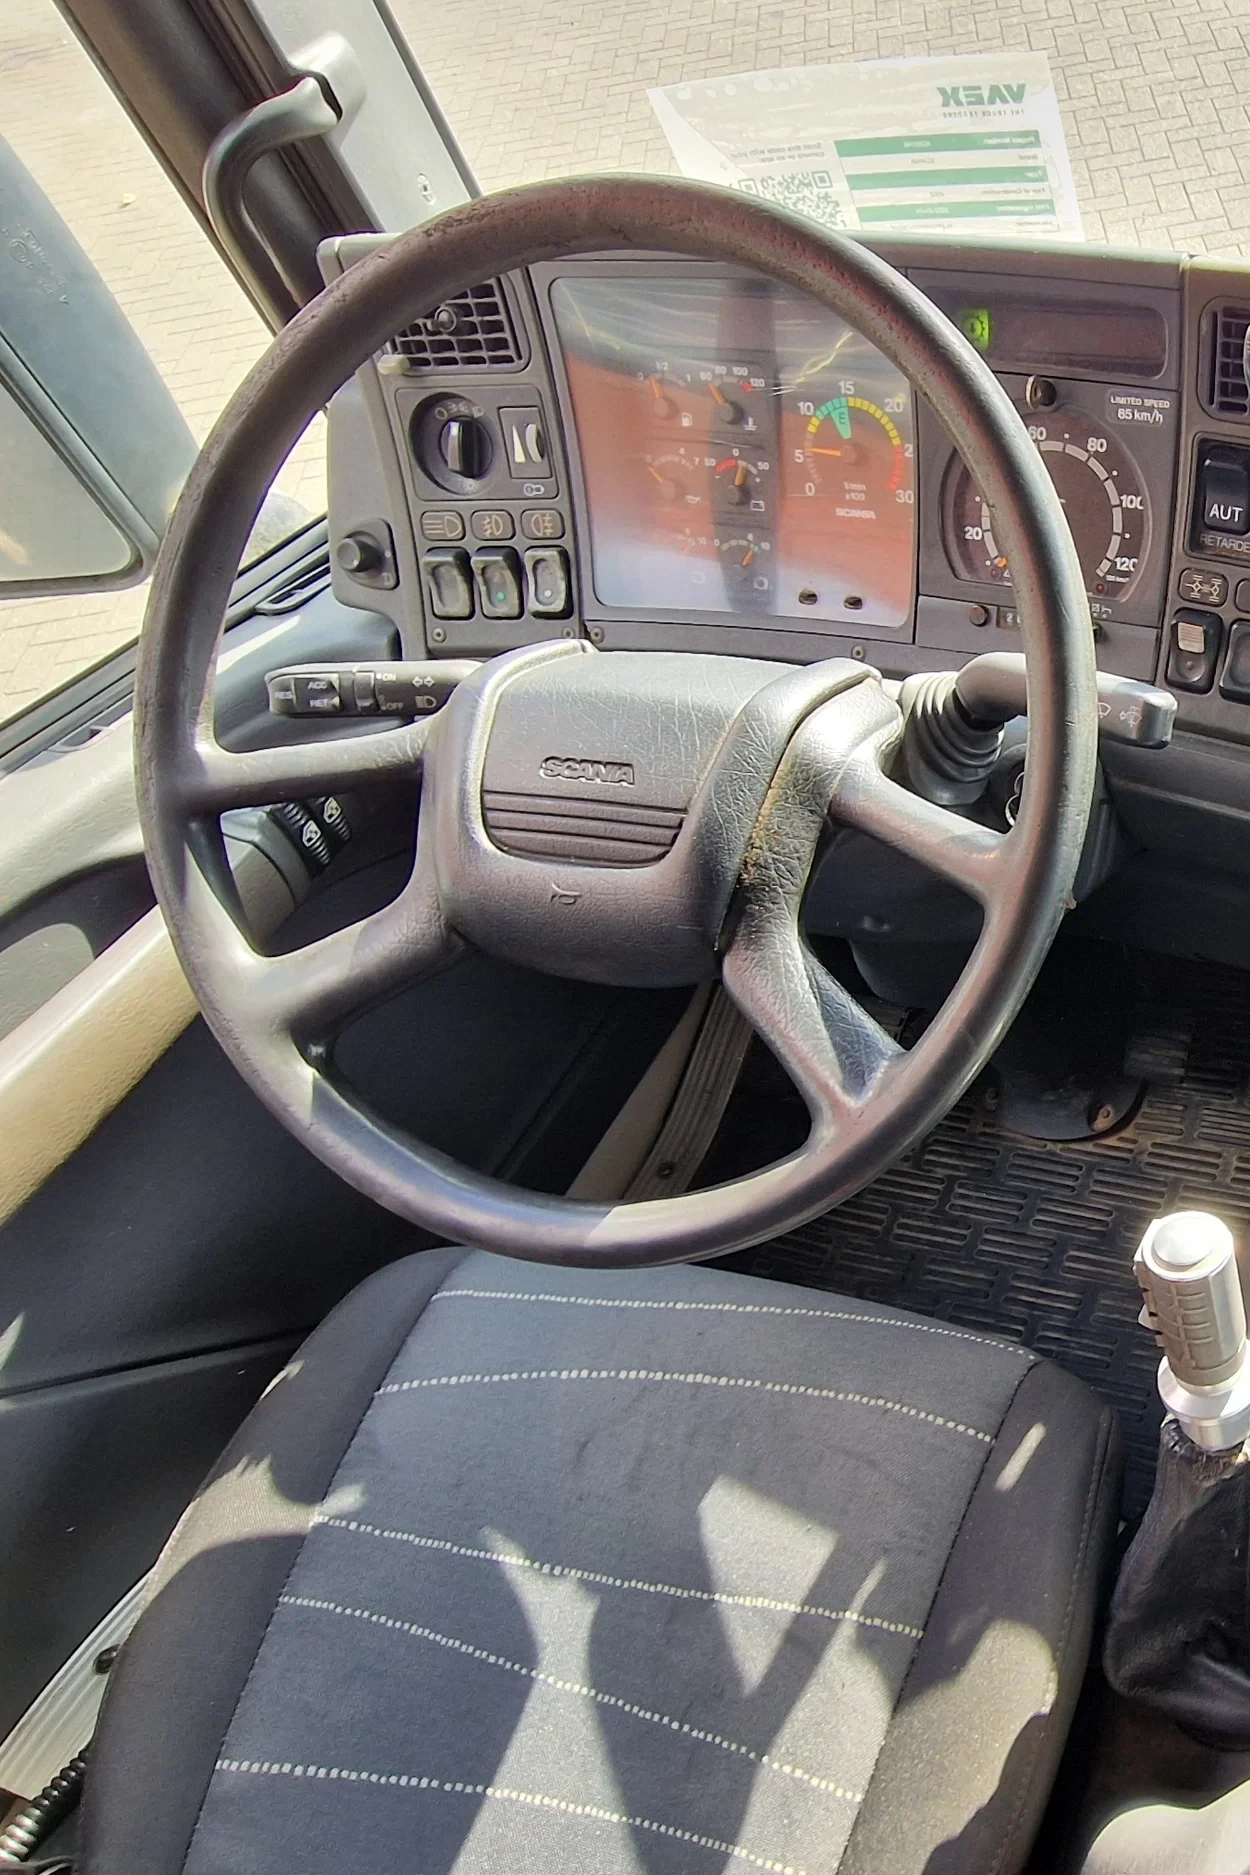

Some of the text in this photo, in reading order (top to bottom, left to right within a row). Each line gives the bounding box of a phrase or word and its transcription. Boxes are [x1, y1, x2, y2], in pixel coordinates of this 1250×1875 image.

[732, 366, 748, 376] 100
[838, 380, 855, 395] 15
[797, 400, 815, 416] 10
[883, 397, 904, 413] 20
[1110, 395, 1170, 409] LIMITED SPEED
[1134, 409, 1163, 425] km/h
[1028, 426, 1047, 441] 60
[904, 443, 914, 458] 2
[1087, 436, 1107, 452] 80
[794, 449, 804, 463] 5
[757, 461, 770, 470] 50
[805, 482, 815, 496] 0
[895, 489, 915, 504] 30
[835, 507, 876, 520] SCANIA
[1209, 503, 1243, 523] AUT
[964, 526, 982, 540] 20
[1114, 556, 1138, 572] 120
[540, 756, 635, 787] SCANIA
